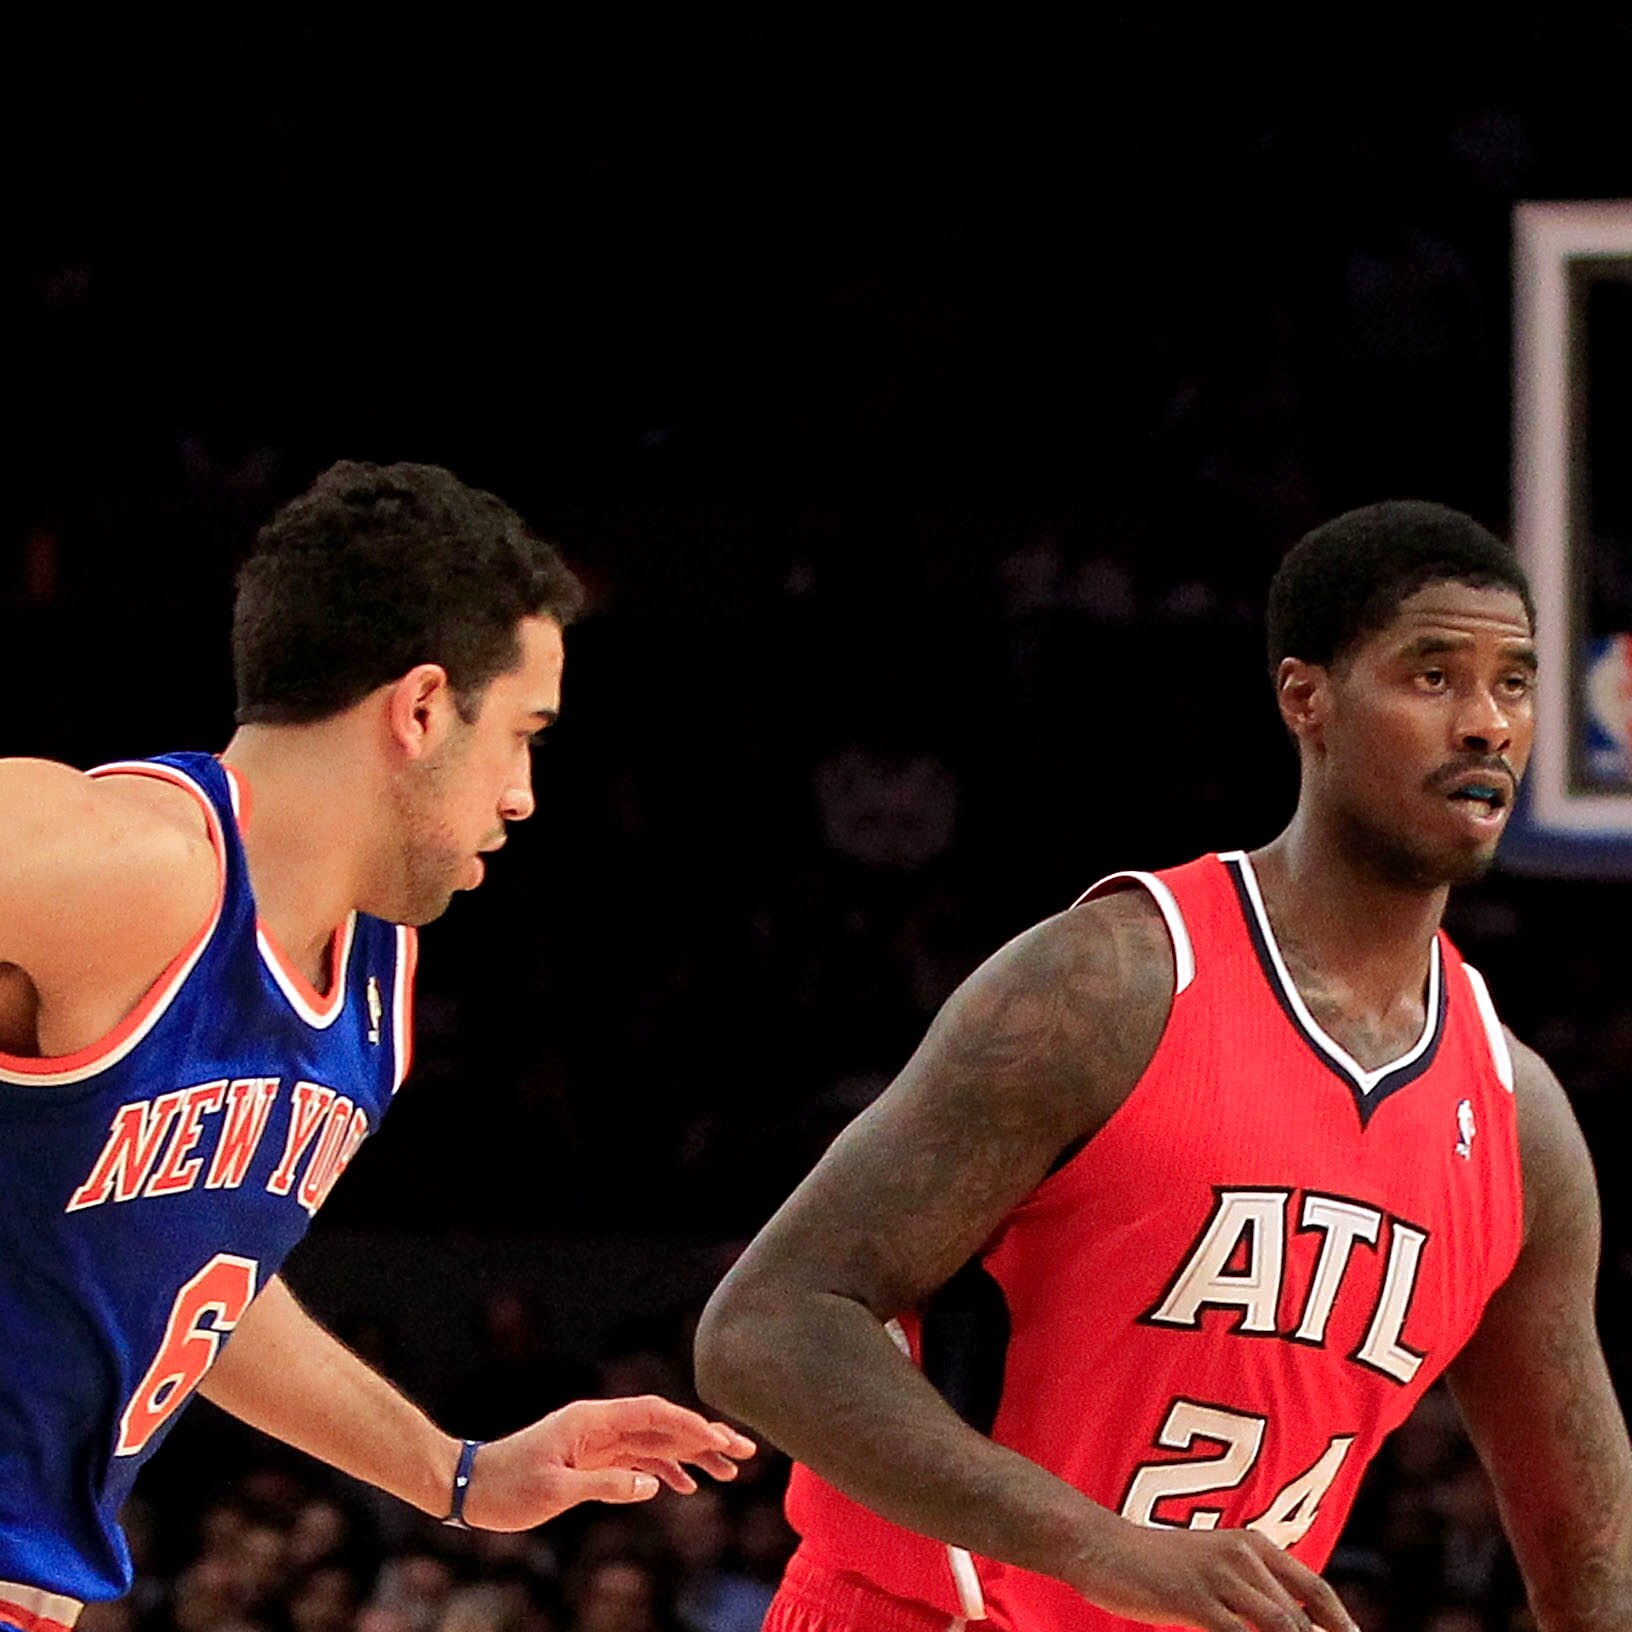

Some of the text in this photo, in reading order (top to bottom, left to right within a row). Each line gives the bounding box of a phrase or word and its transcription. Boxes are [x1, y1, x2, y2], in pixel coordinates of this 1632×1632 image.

[66, 1077, 280, 1213] NEW
[114, 1253, 259, 1457] 6
[1136, 1185, 1430, 1385] ATL
[1120, 1396, 1356, 1550] 24
